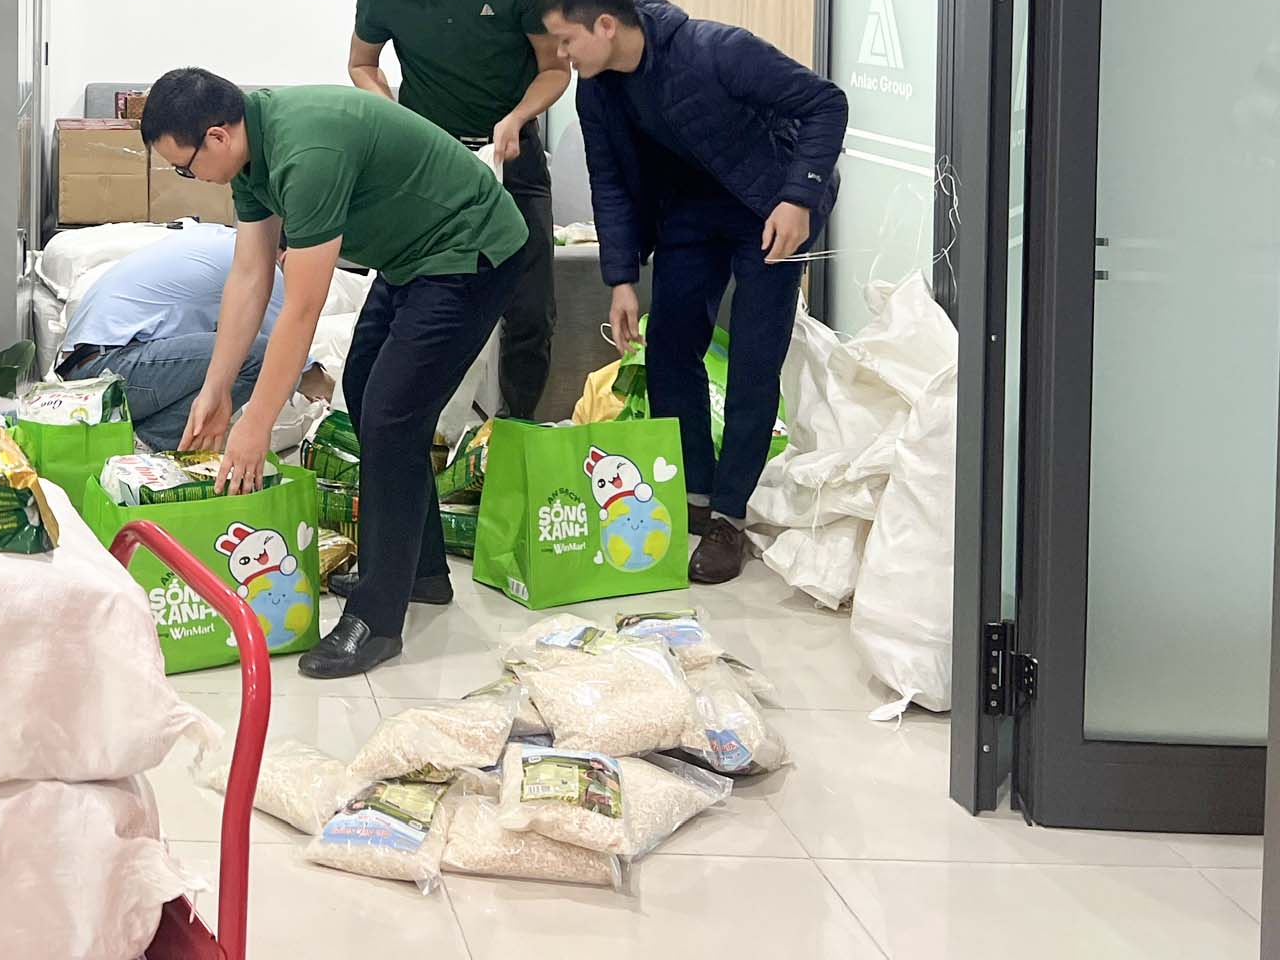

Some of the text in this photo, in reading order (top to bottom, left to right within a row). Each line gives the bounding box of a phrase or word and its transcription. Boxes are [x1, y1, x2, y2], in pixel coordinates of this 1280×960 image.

[850, 71, 913, 102] Anlac Group
[538, 499, 588, 526] SỐNG
[538, 521, 589, 542] XANH
[148, 578, 200, 610] SỐN
[169, 623, 216, 640] WinMart
